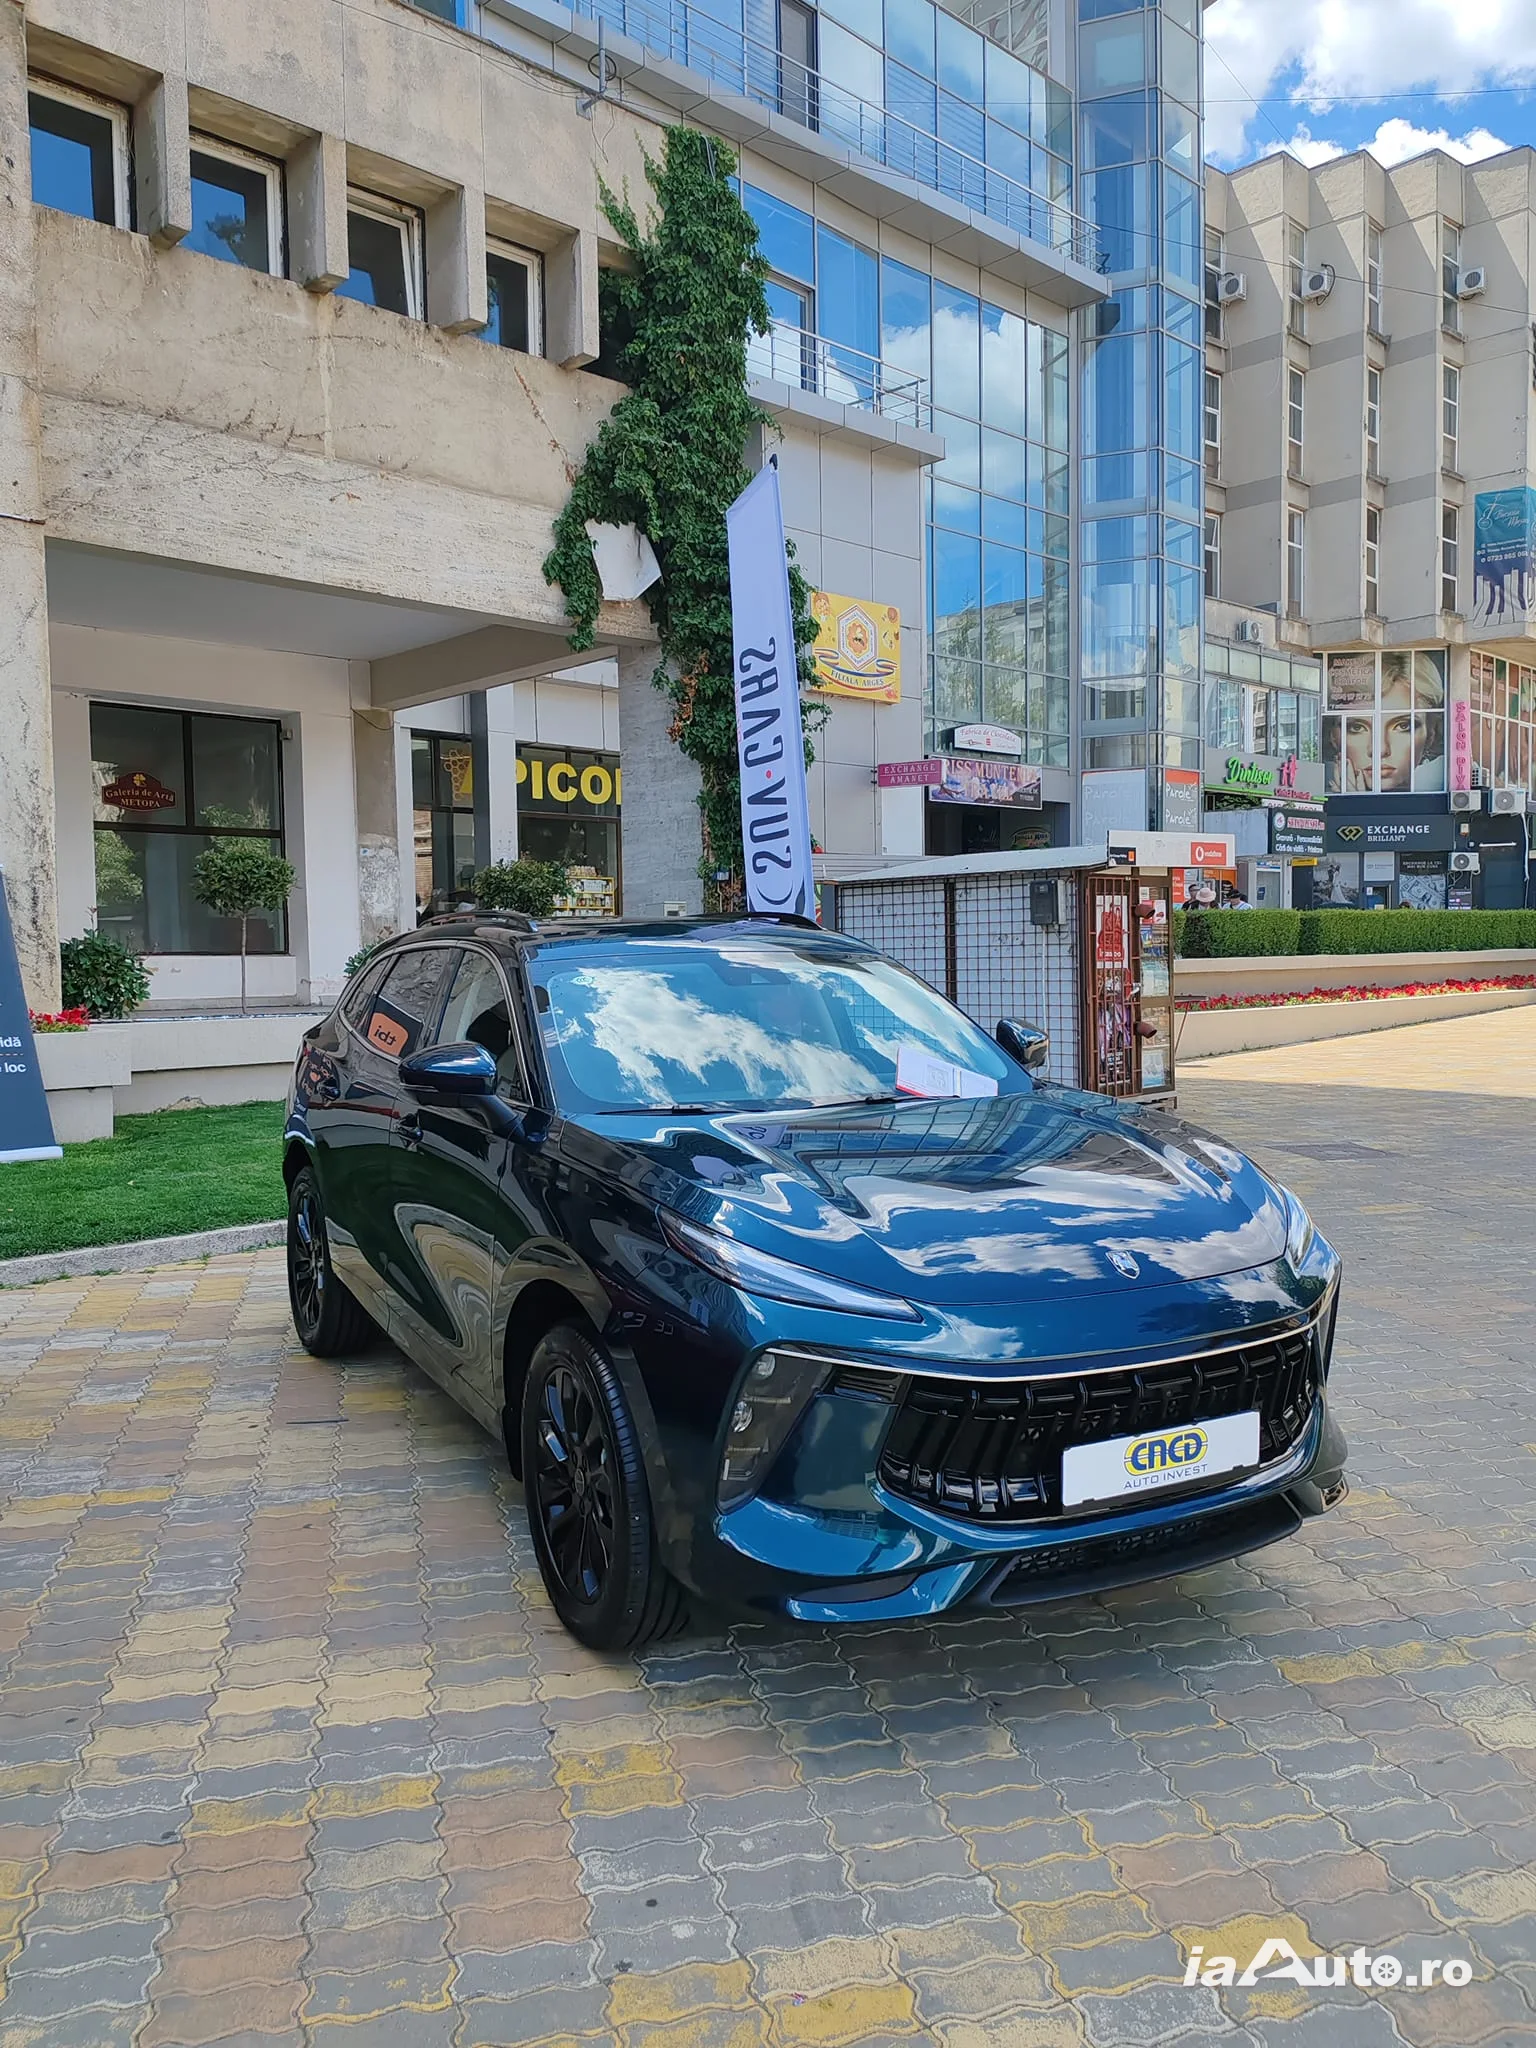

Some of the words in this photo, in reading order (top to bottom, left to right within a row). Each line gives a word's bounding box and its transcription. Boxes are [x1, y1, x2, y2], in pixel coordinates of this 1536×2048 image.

[884, 763, 936, 774] EXCHANGE
[890, 774, 929, 784] AMANET
[105, 788, 140, 798] Galeria
[142, 788, 152, 797] de
[121, 798, 160, 808] METOPA
[1367, 824, 1430, 835] EXCHANGE
[1367, 834, 1407, 842] BRILIANT
[4, 1062, 27, 1073] loc
[1124, 1475, 1160, 1490] AUTO
[1163, 1464, 1208, 1482] INVEST
